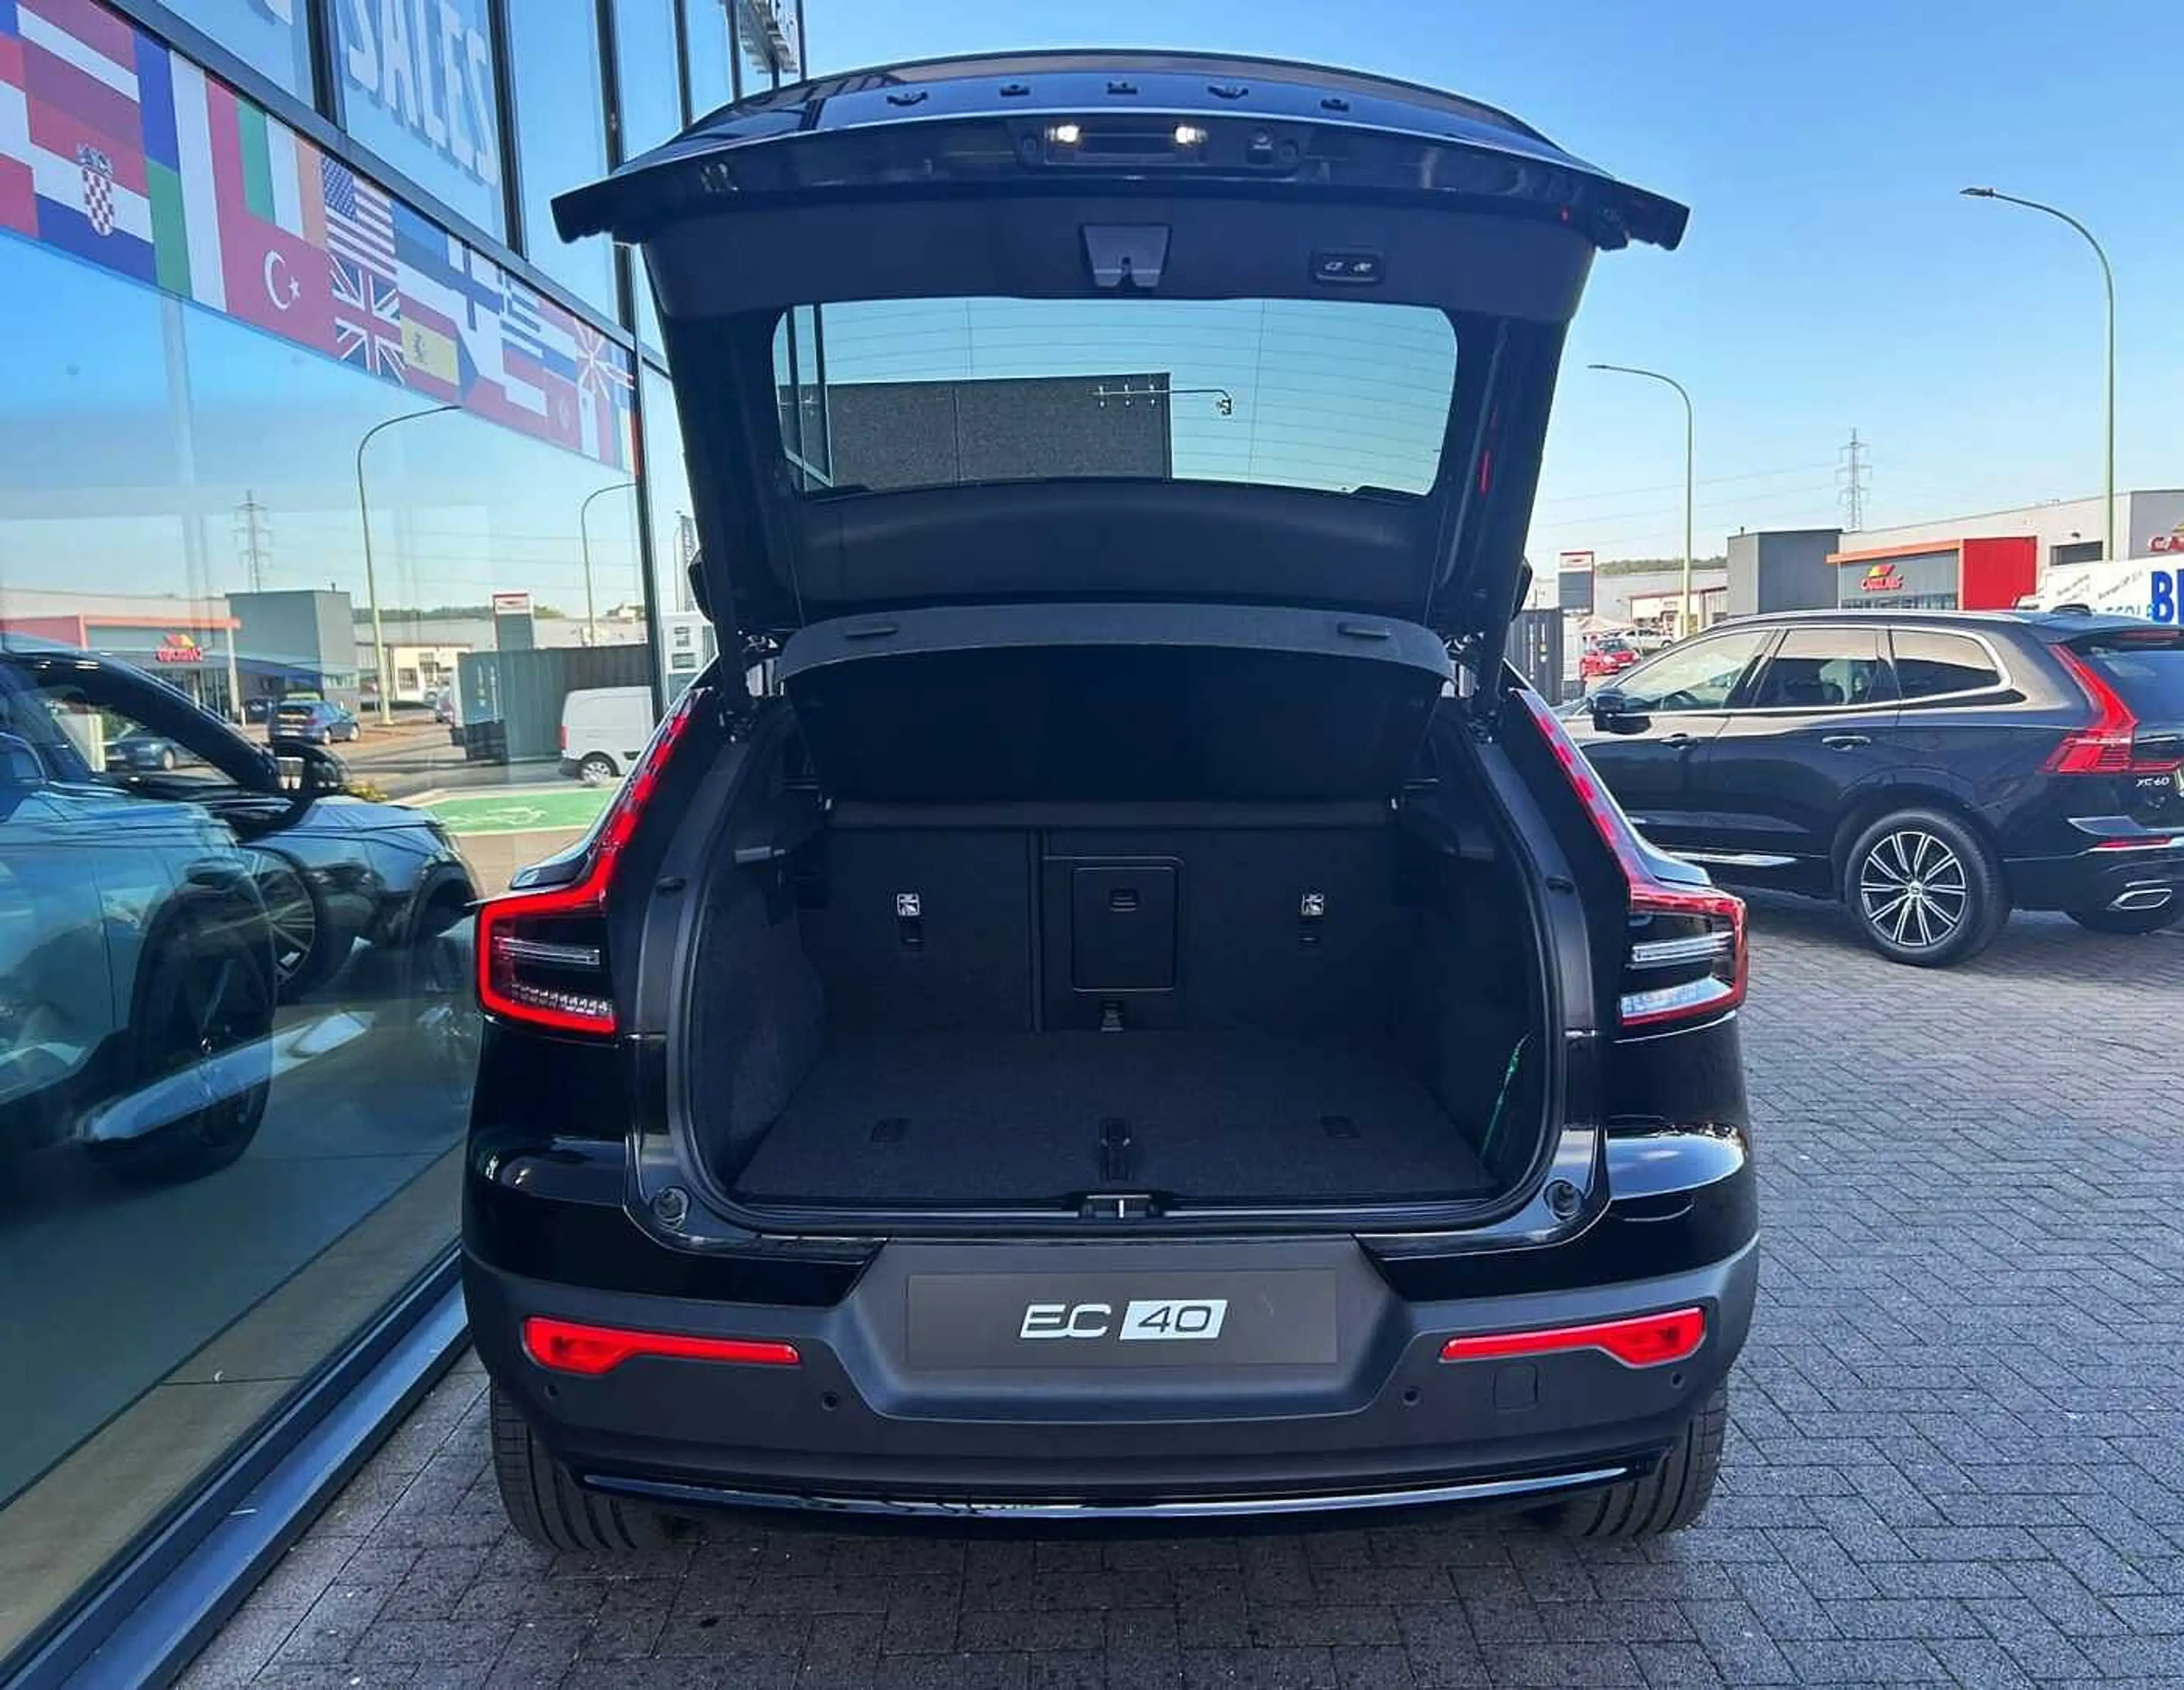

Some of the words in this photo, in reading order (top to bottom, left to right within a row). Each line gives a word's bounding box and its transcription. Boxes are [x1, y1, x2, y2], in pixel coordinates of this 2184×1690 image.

[2136, 776, 2170, 787] XC60
[1019, 1303, 1112, 1339] EC
[1135, 1304, 1214, 1334] 40
